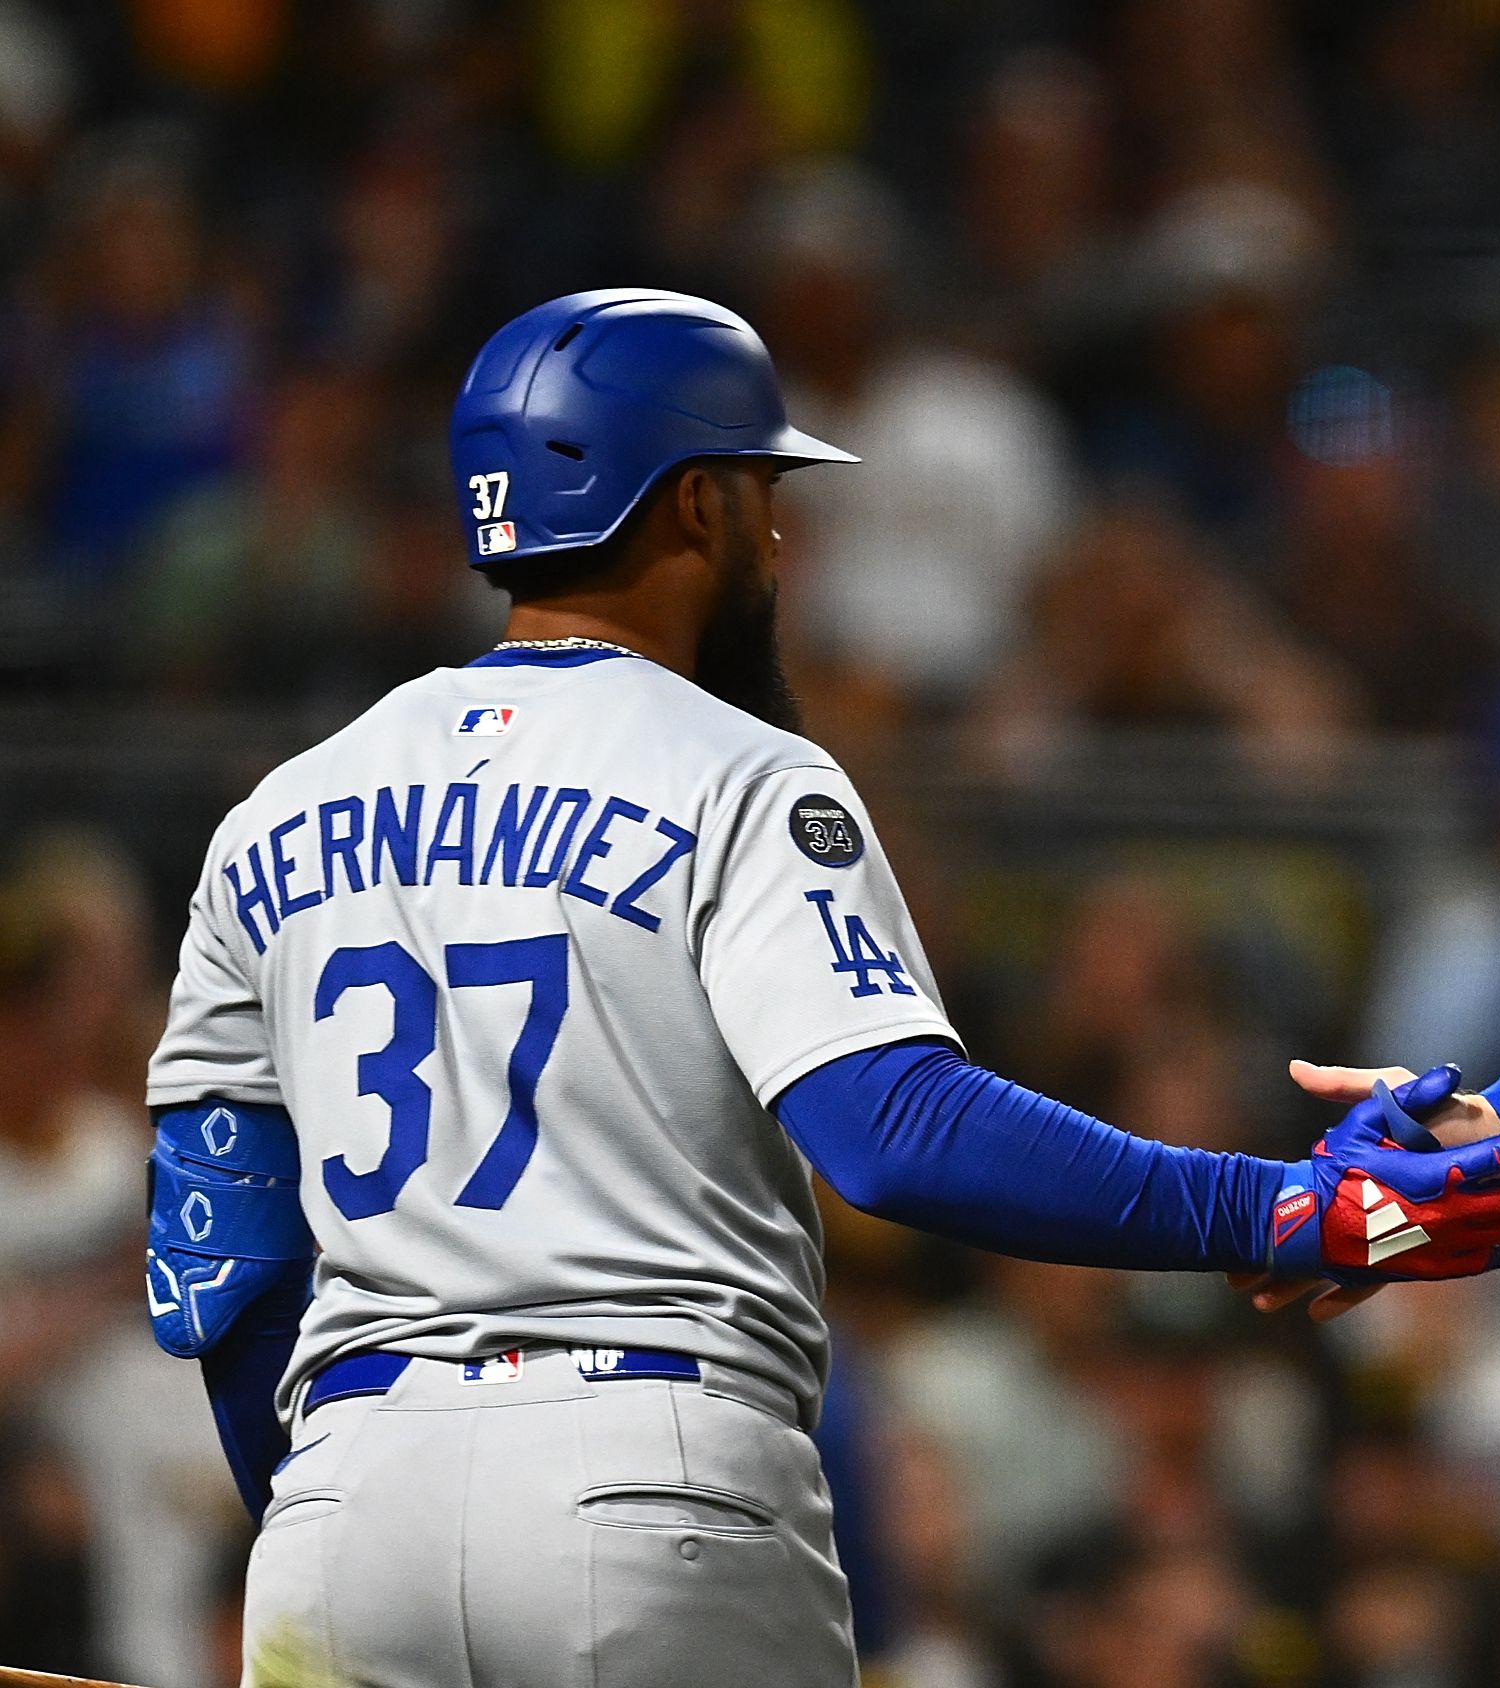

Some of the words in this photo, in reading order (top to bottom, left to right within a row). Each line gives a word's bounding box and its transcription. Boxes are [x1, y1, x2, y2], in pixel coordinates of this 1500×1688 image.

[468, 471, 509, 520] 37
[223, 758, 698, 956] HERNÁNDEZ
[804, 820, 854, 853] 34
[803, 889, 918, 998] LA
[315, 932, 569, 1222] 37
